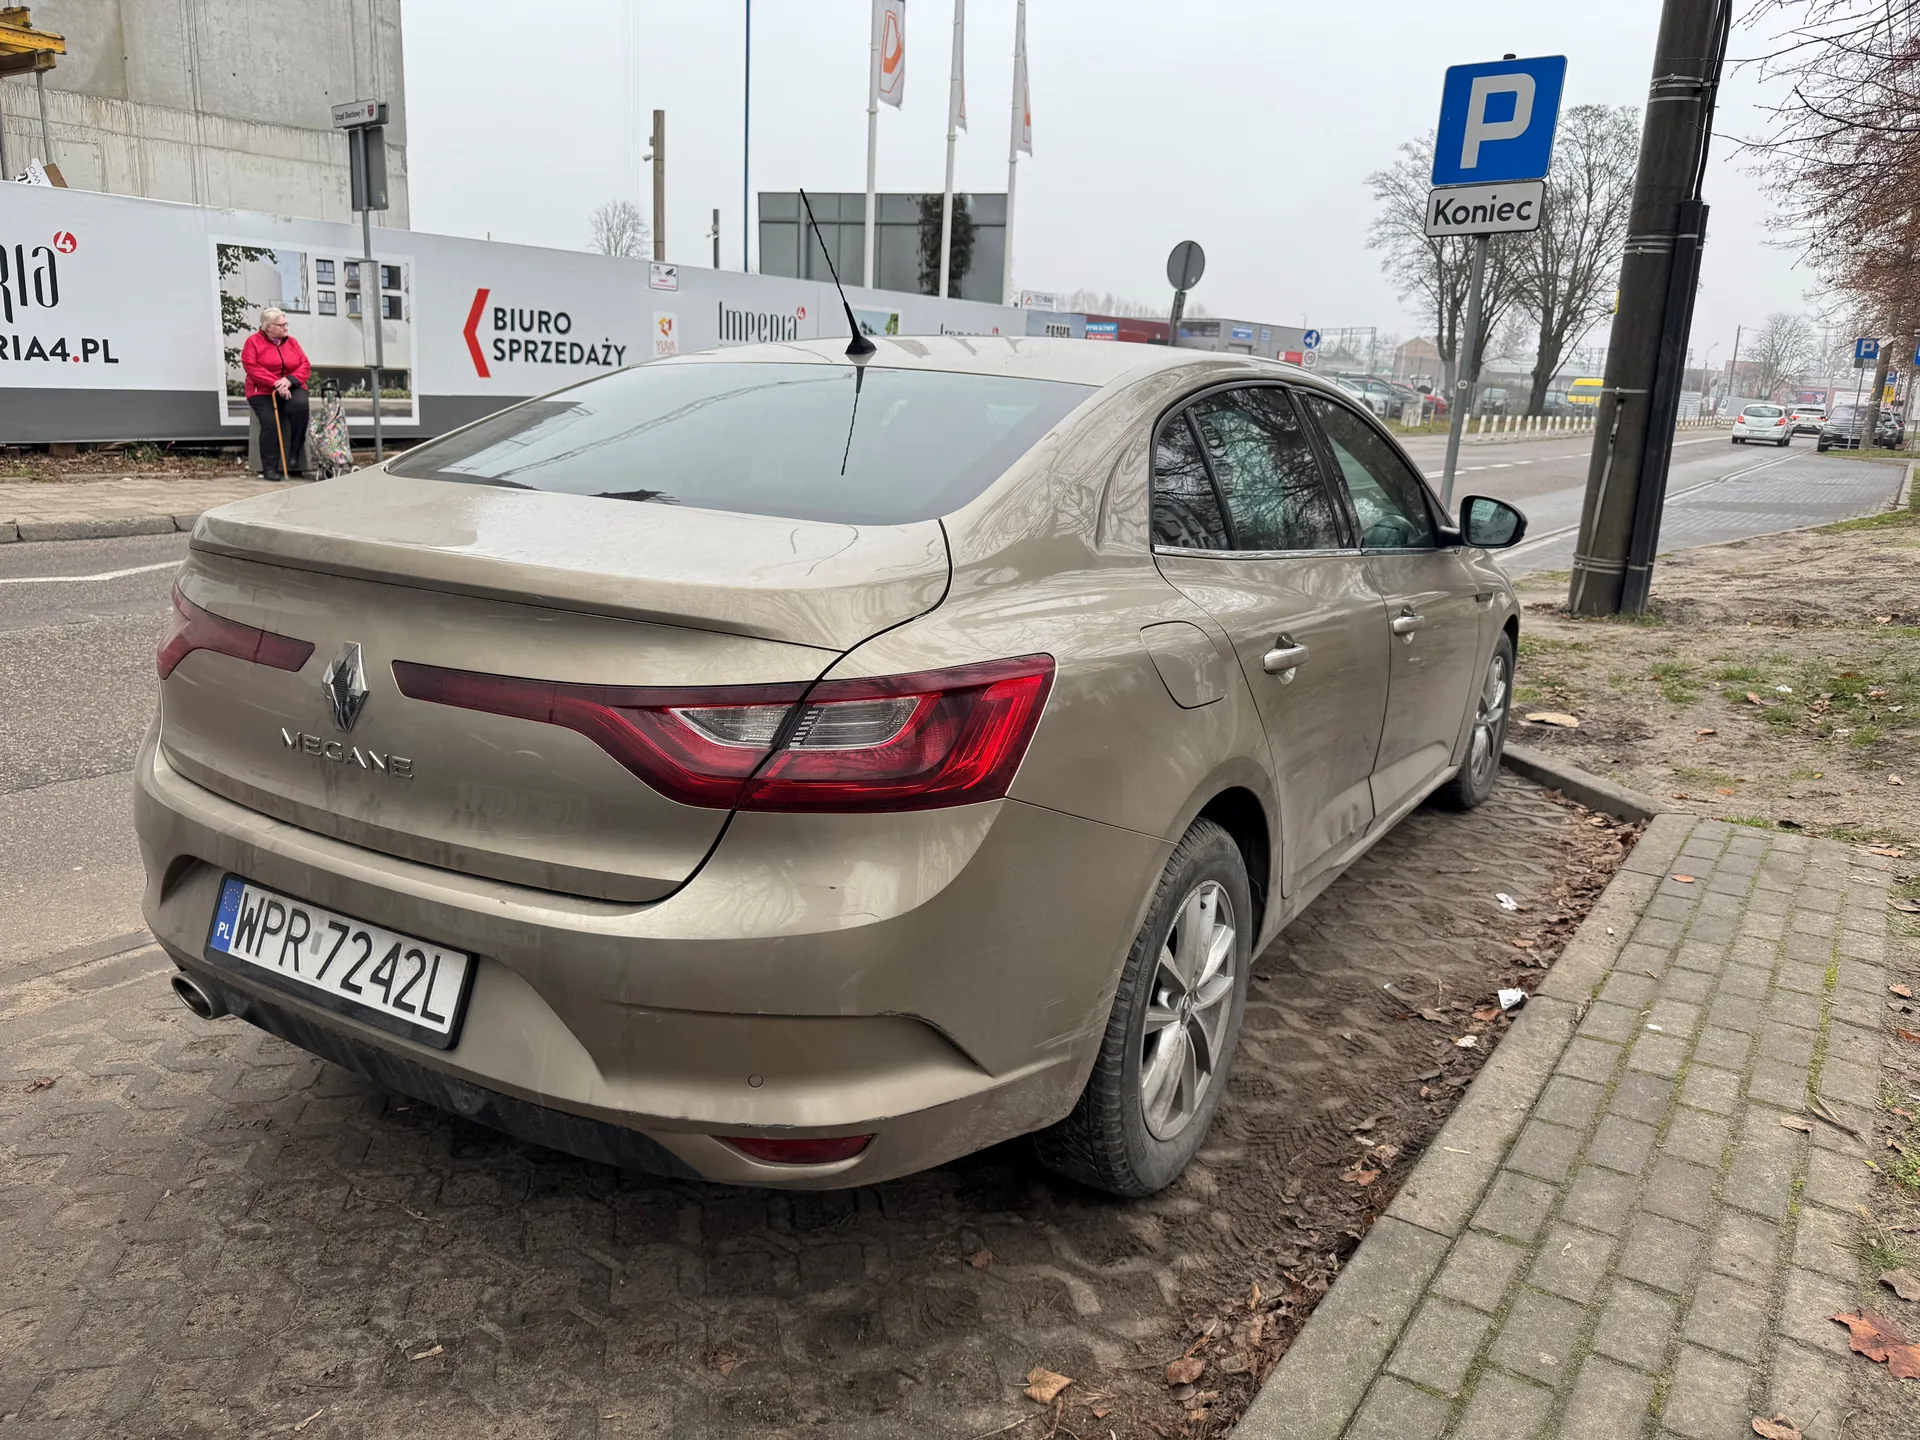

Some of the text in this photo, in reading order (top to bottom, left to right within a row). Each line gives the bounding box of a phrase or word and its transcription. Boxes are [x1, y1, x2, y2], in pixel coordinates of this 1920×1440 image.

[1460, 73, 1536, 170] P
[1433, 195, 1533, 227] Koniec
[493, 307, 572, 335] BIURO
[493, 337, 627, 367] SPRZEDAŻY
[281, 727, 413, 779] MEGANE
[216, 921, 230, 940] PL
[233, 891, 447, 1026] WPR 7242L
